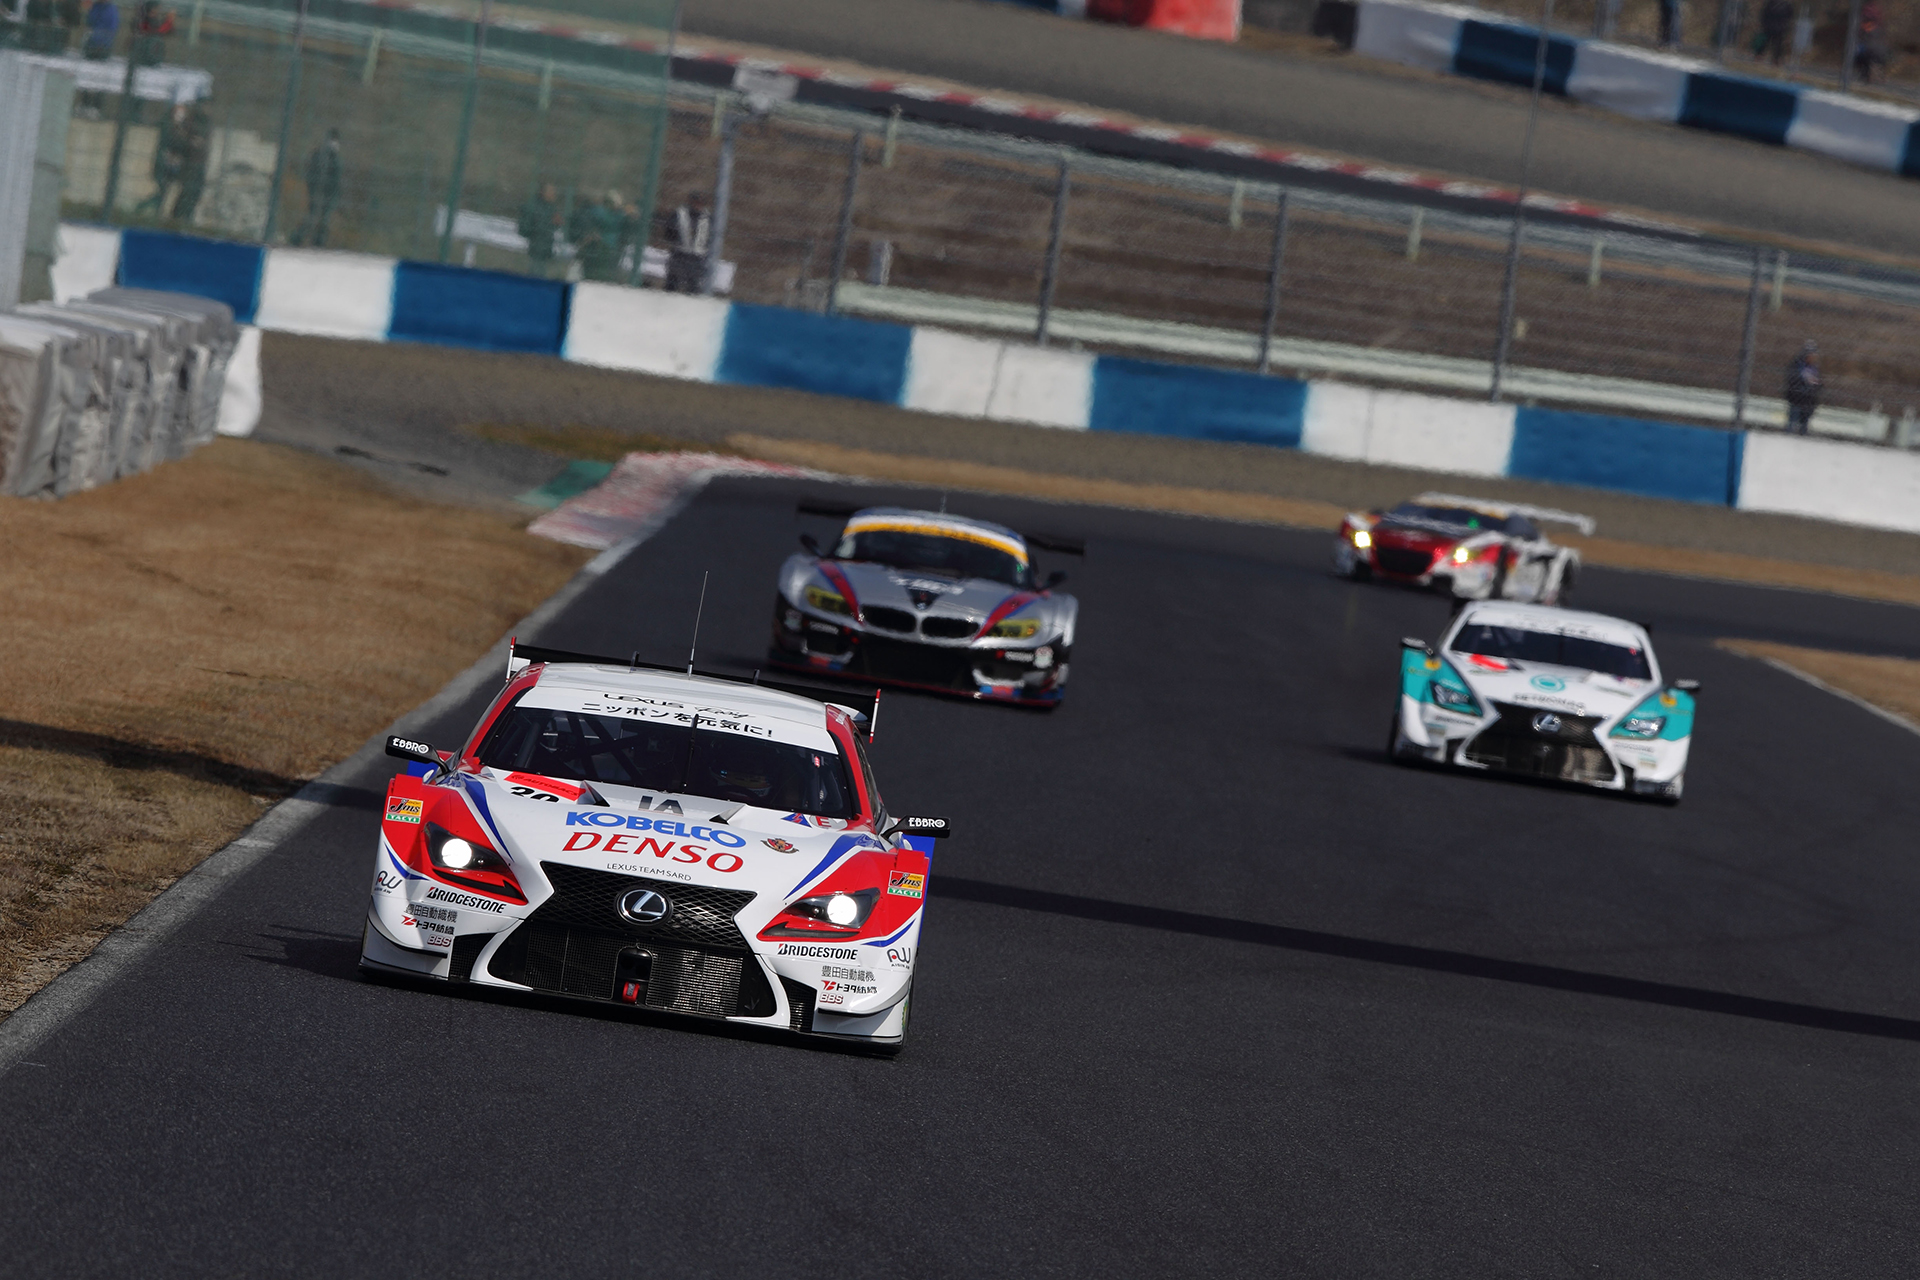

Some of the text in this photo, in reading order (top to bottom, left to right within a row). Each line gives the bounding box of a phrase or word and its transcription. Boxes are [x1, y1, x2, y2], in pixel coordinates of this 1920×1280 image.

[604, 693, 684, 709] LEXUS
[392, 737, 430, 754] EBBRO
[565, 811, 747, 848] KOBELCO
[908, 817, 946, 828] EBBRO
[562, 831, 744, 873] DENSO
[606, 863, 692, 881] LEXUS TEAM SARD
[426, 886, 507, 914] BRIDGESTONE
[427, 934, 452, 948] BBS
[777, 943, 858, 960] BRIDGESTONE
[819, 992, 844, 1005] BBS
